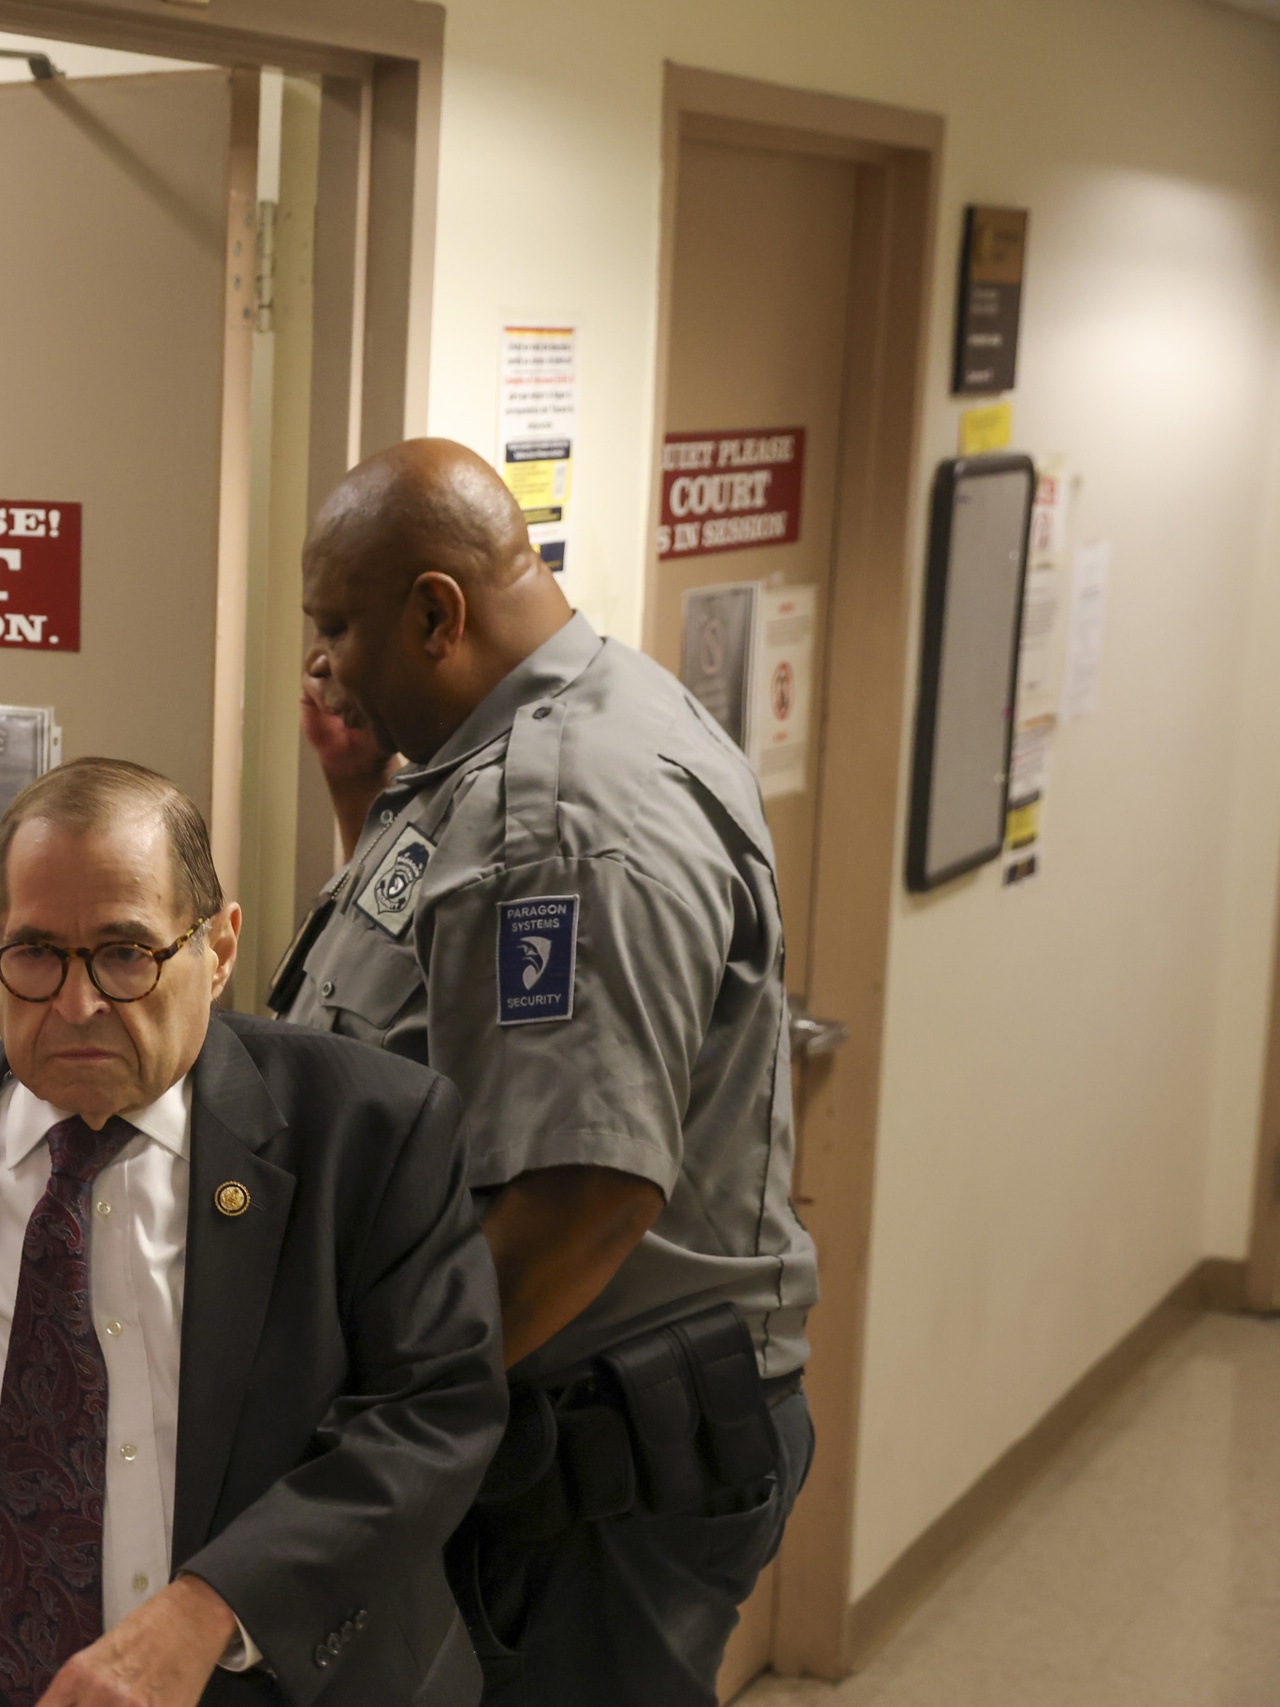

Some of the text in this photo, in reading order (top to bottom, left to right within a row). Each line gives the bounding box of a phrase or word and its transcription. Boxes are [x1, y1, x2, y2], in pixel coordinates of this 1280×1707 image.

[670, 470, 772, 517] COURT
[507, 904, 567, 919] PARAGON
[511, 918, 560, 932] SYSTEMS
[507, 994, 562, 1008] SECURITY
